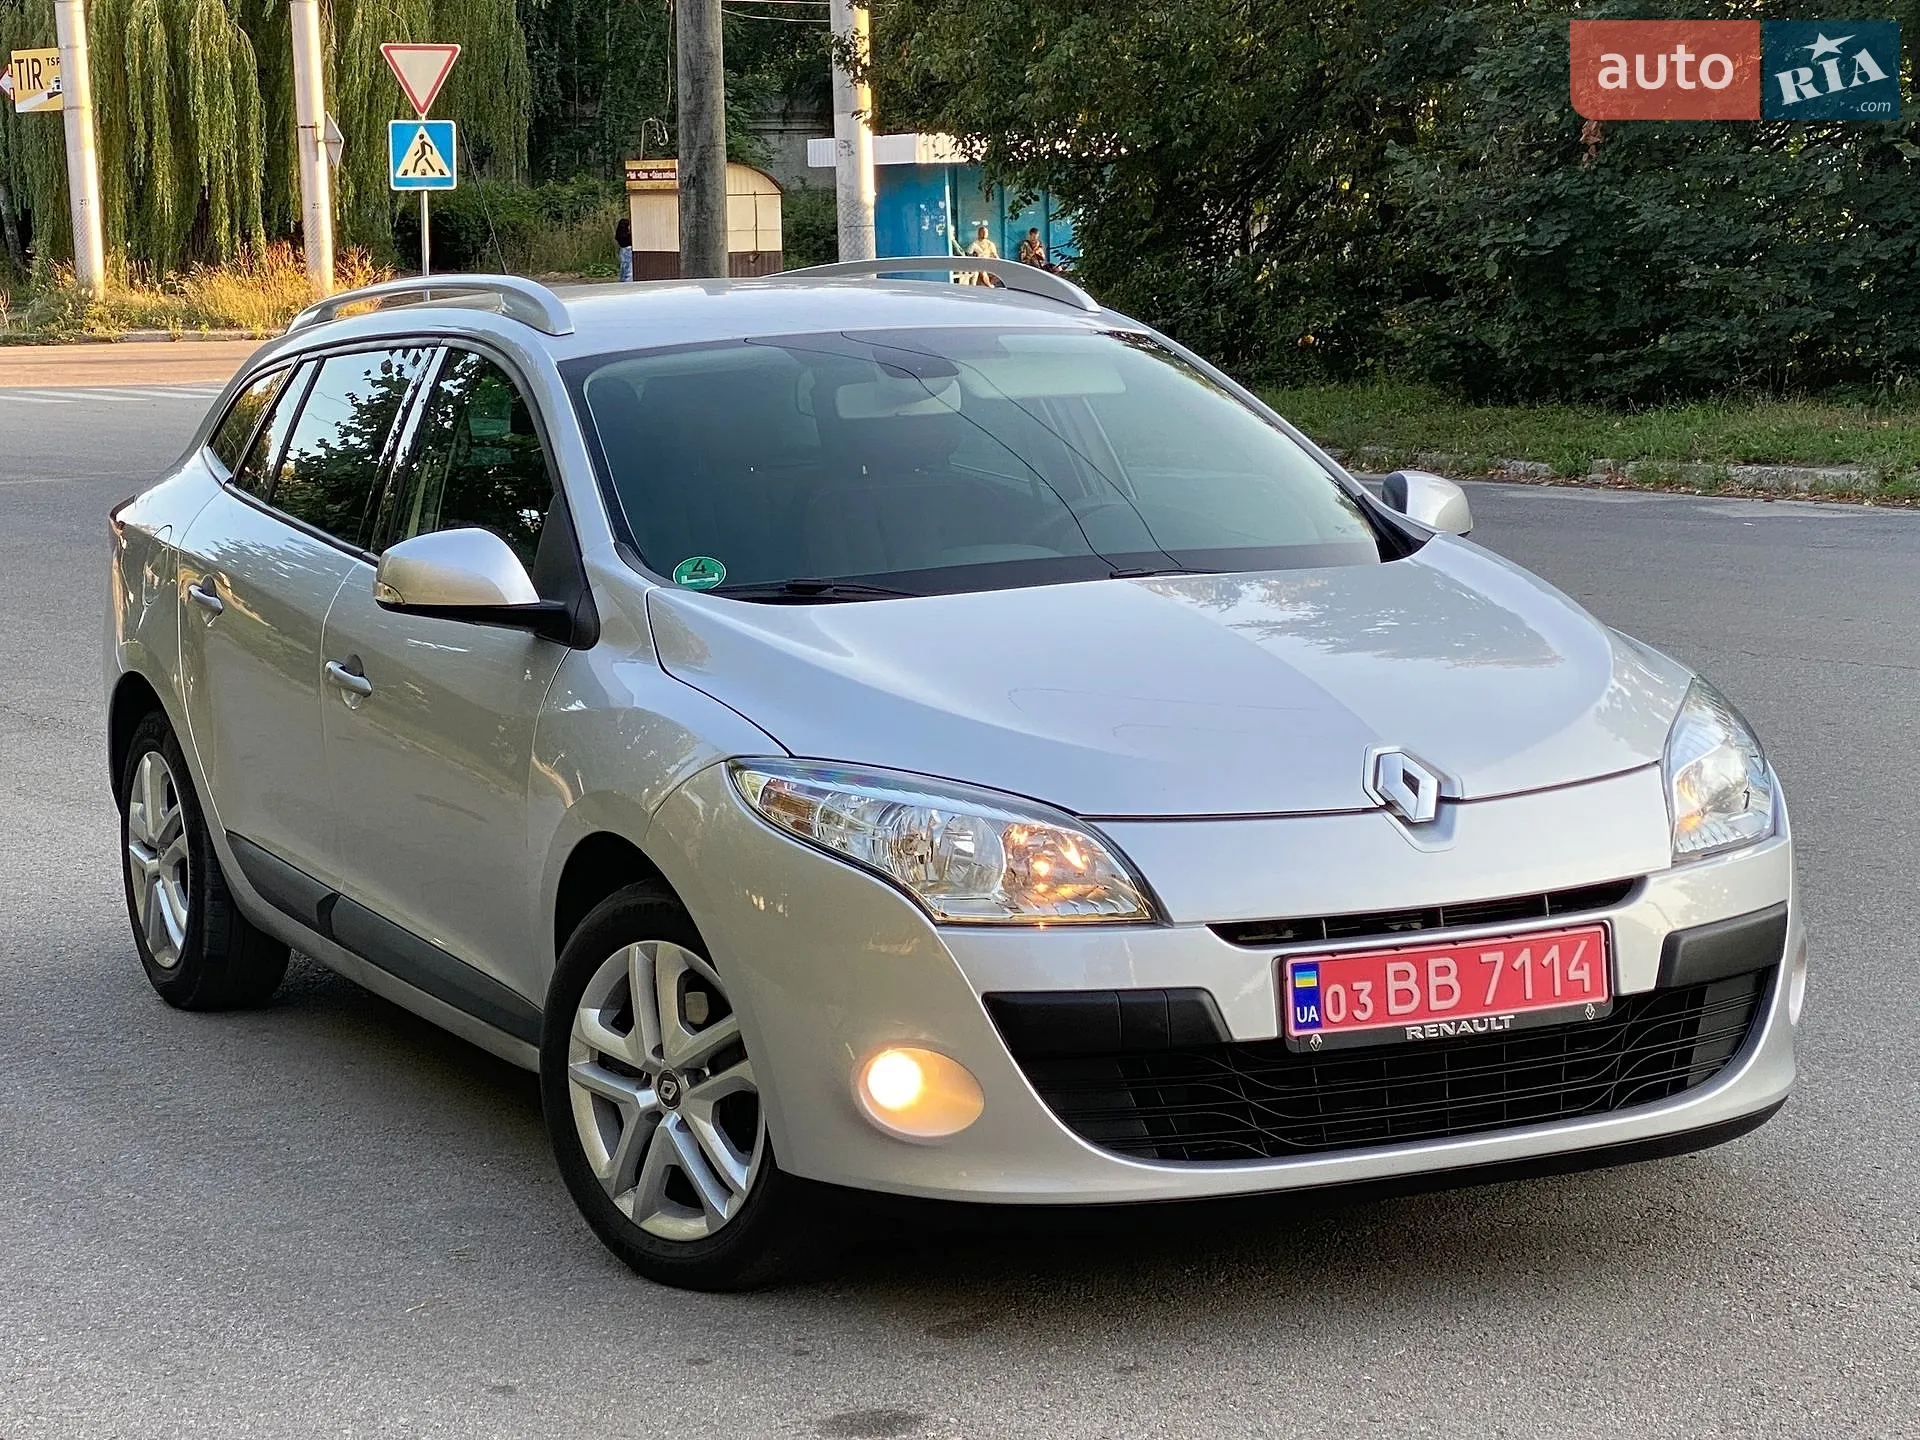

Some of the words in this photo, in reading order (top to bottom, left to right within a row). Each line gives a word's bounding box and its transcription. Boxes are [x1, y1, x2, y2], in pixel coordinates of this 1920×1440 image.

[14, 58, 44, 90] TIR
[1325, 981, 1375, 1023] 03
[1386, 957, 1462, 1016] BB
[1480, 939, 1591, 1006] 7114
[1296, 1005, 1320, 1023] UA
[1405, 1015, 1515, 1041] RENAULT
